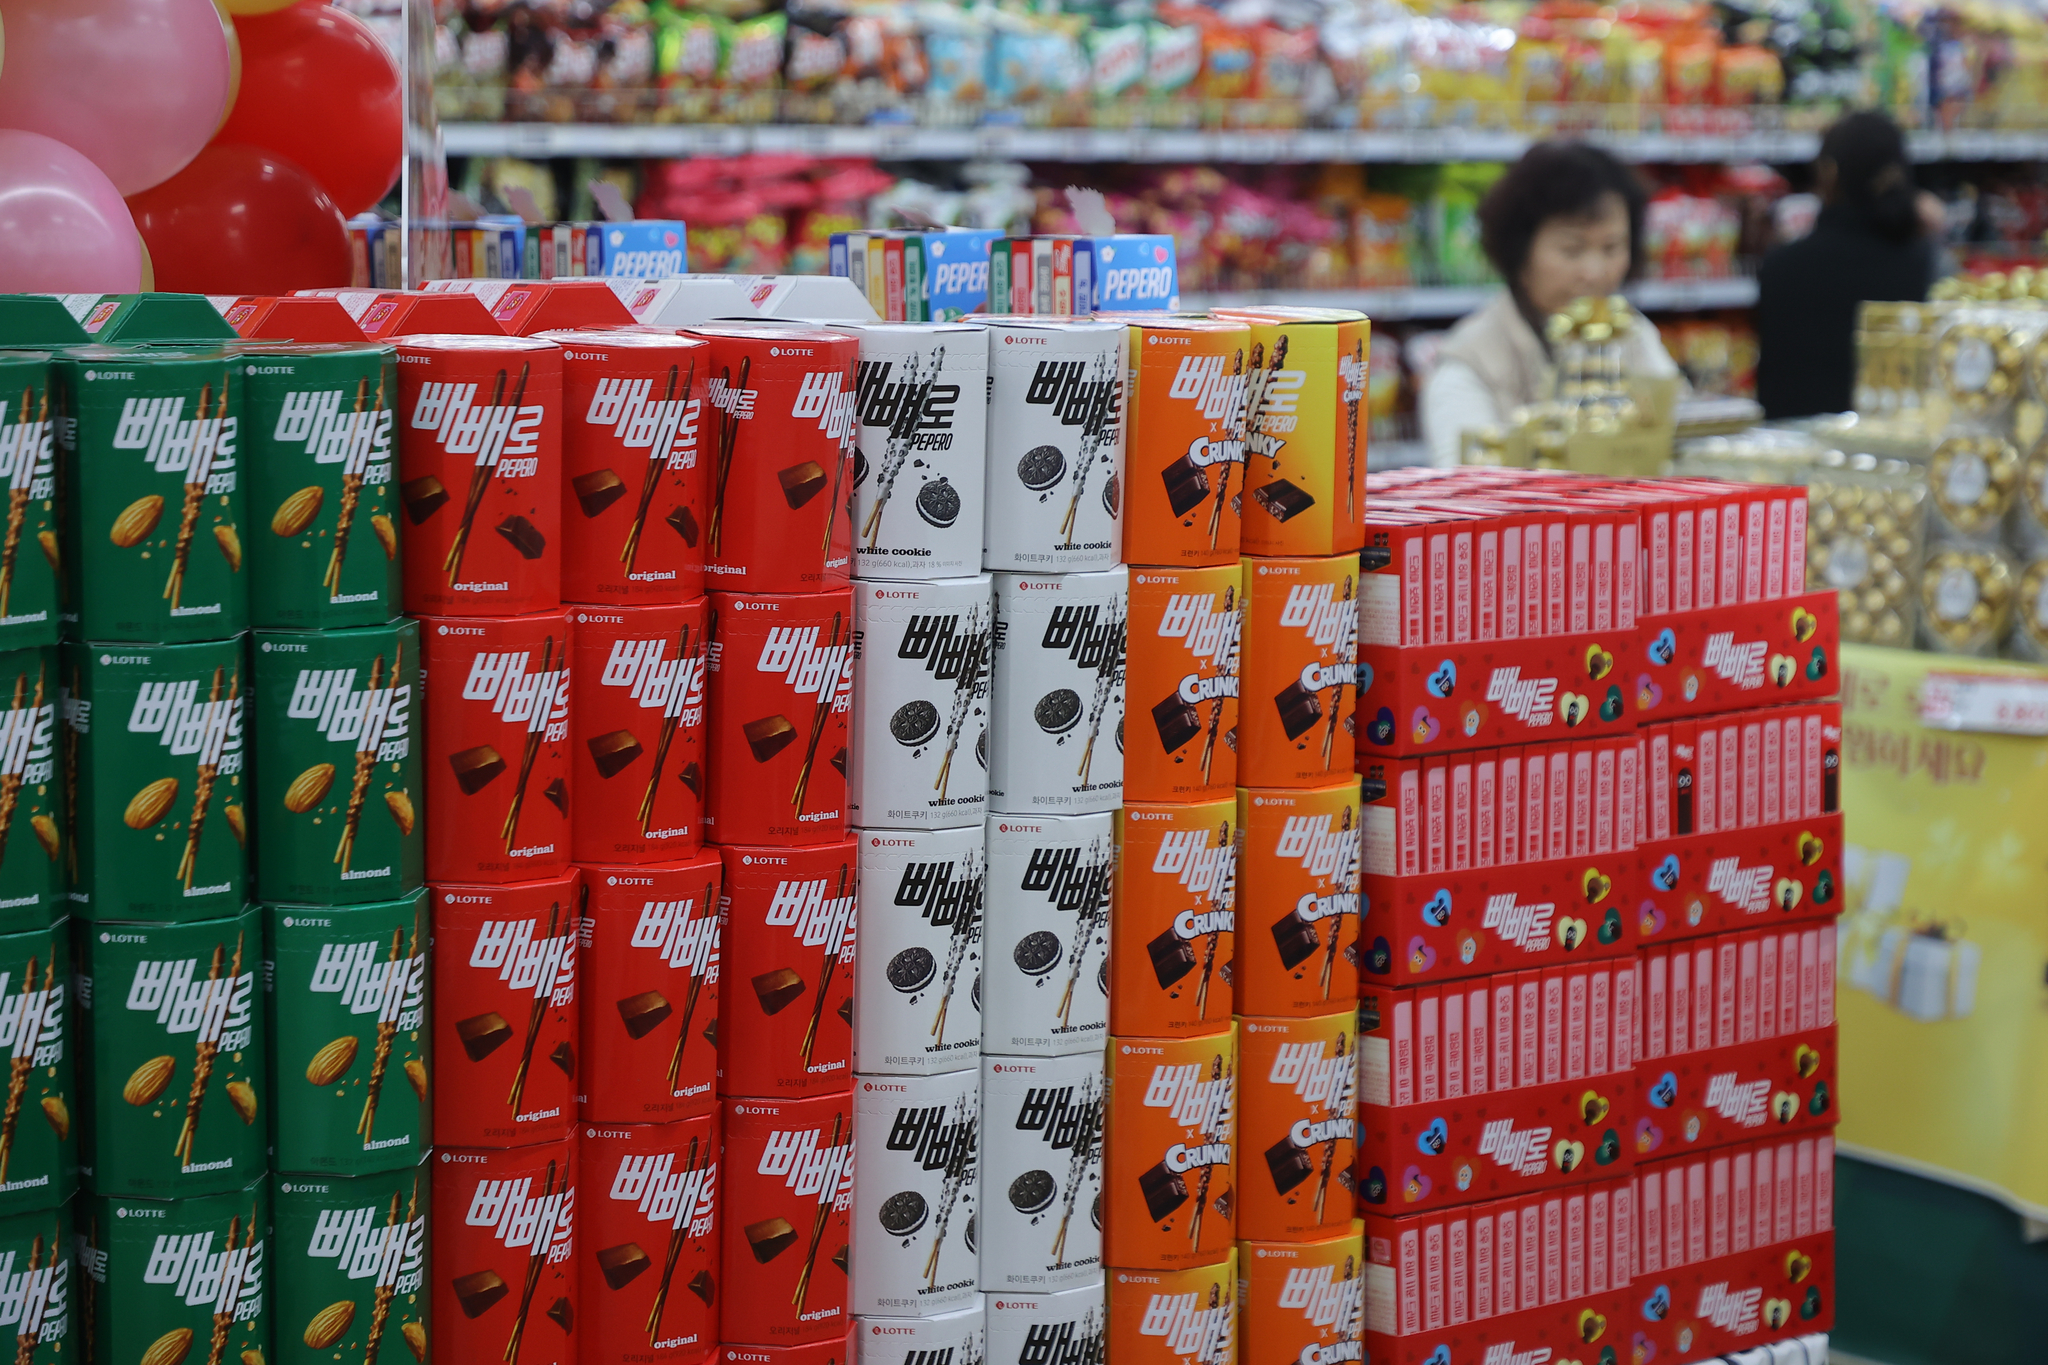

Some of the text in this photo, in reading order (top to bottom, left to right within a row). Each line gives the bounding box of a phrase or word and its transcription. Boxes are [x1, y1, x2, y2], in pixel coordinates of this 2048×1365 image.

[610, 250, 682, 277] PEPERO
[934, 261, 989, 294] PEPER
[1105, 266, 1172, 299] PEPERO
[1015, 337, 1047, 345] LOTTE
[1159, 337, 1191, 345] LOTTE
[575, 352, 608, 361] LOTTE
[781, 348, 814, 356] LOTTE
[401, 356, 431, 364] LOTTE
[98, 372, 135, 380] LOTTE
[732, 411, 754, 419] PEPERO
[791, 372, 856, 448] 빼빼
[586, 378, 701, 459] 빼빼로
[411, 382, 544, 466] 빼빼로
[1256, 415, 1298, 433] PEPERO
[273, 390, 392, 474] 빼빼로
[910, 433, 954, 451] PEPERO
[1188, 437, 1245, 467] CRUNK
[496, 458, 538, 478] PEPERO
[856, 546, 931, 557] white cookie
[1054, 543, 1080, 552] white
[826, 556, 848, 568] original
[1014, 553, 1053, 563] 화이트쿠키
[858, 559, 870, 569] 132
[629, 570, 676, 582] original
[1268, 567, 1300, 575] LOTTE
[1147, 576, 1179, 584] LOTTE
[454, 581, 508, 592] original
[1031, 582, 1062, 590] LOTTE
[330, 591, 378, 603] almond
[887, 591, 919, 599] LOTTE
[170, 603, 221, 616] almond
[746, 602, 779, 610] LOTTE
[590, 615, 623, 623] LOTTE
[450, 627, 485, 635] LOTTE
[272, 644, 308, 652] LOTTE
[112, 656, 150, 665] LOTTE
[1704, 631, 1768, 685] 빼빼로
[1486, 665, 1558, 721] 빼빼로
[287, 668, 410, 752] 빼빼로
[1072, 784, 1097, 793] white
[928, 798, 955, 807] white
[1032, 795, 1071, 806] 화이트쿠키
[1264, 798, 1295, 806] LOTTE
[799, 811, 838, 822] original
[887, 809, 927, 820] 화이트쿠키
[1141, 813, 1173, 821] LOTTE
[646, 827, 688, 839] original
[1010, 825, 1041, 833] LOTTE
[883, 839, 915, 847] LOTTE
[510, 844, 554, 859] original
[754, 856, 787, 865] LOTTE
[341, 867, 390, 880] almond
[619, 877, 654, 886] LOTTE
[1708, 857, 1774, 909] 빼빼로
[183, 883, 231, 897] almond
[457, 896, 492, 904] LOTTE
[295, 918, 331, 927] LOTTE
[1482, 893, 1555, 947] 빼빼로
[111, 934, 147, 943] LOTTE
[126, 959, 253, 1043] 빼빼로
[1051, 1026, 1077, 1035] white
[1259, 1025, 1289, 1033] LOTTE
[925, 1043, 951, 1052] white
[1133, 1046, 1164, 1054] LOTTE
[807, 1061, 845, 1073] original
[1005, 1065, 1036, 1073] LOTTE
[674, 1083, 710, 1097] original
[875, 1084, 907, 1092] LOTTE
[1704, 1072, 1771, 1123] 빼빼로
[516, 1107, 559, 1122] original
[746, 1106, 779, 1115] LOTTE
[598, 1130, 631, 1139] LOTTE
[363, 1134, 409, 1151] almond
[1479, 1118, 1552, 1172] 빼빼로
[452, 1155, 487, 1164] LOTTE
[181, 1158, 232, 1174] almond
[293, 1184, 329, 1193] LOTTE
[609, 1154, 716, 1230] 빼빼로
[129, 1208, 166, 1218] LOTTE
[465, 1177, 574, 1256] 빼빼로
[307, 1207, 424, 1287] 빼빼로
[1267, 1249, 1298, 1258] LOTTE
[1046, 1262, 1072, 1272] white
[144, 1231, 263, 1315] 빼빼로
[1129, 1276, 1160, 1284] LOTTE
[917, 1285, 944, 1295] white
[1008, 1302, 1038, 1310] LOTTE
[1697, 1281, 1762, 1330] 빼빼로
[800, 1306, 840, 1321] original
[883, 1327, 915, 1335] LOTTE
[654, 1334, 697, 1350] original
[738, 1352, 770, 1362] LOTTE
